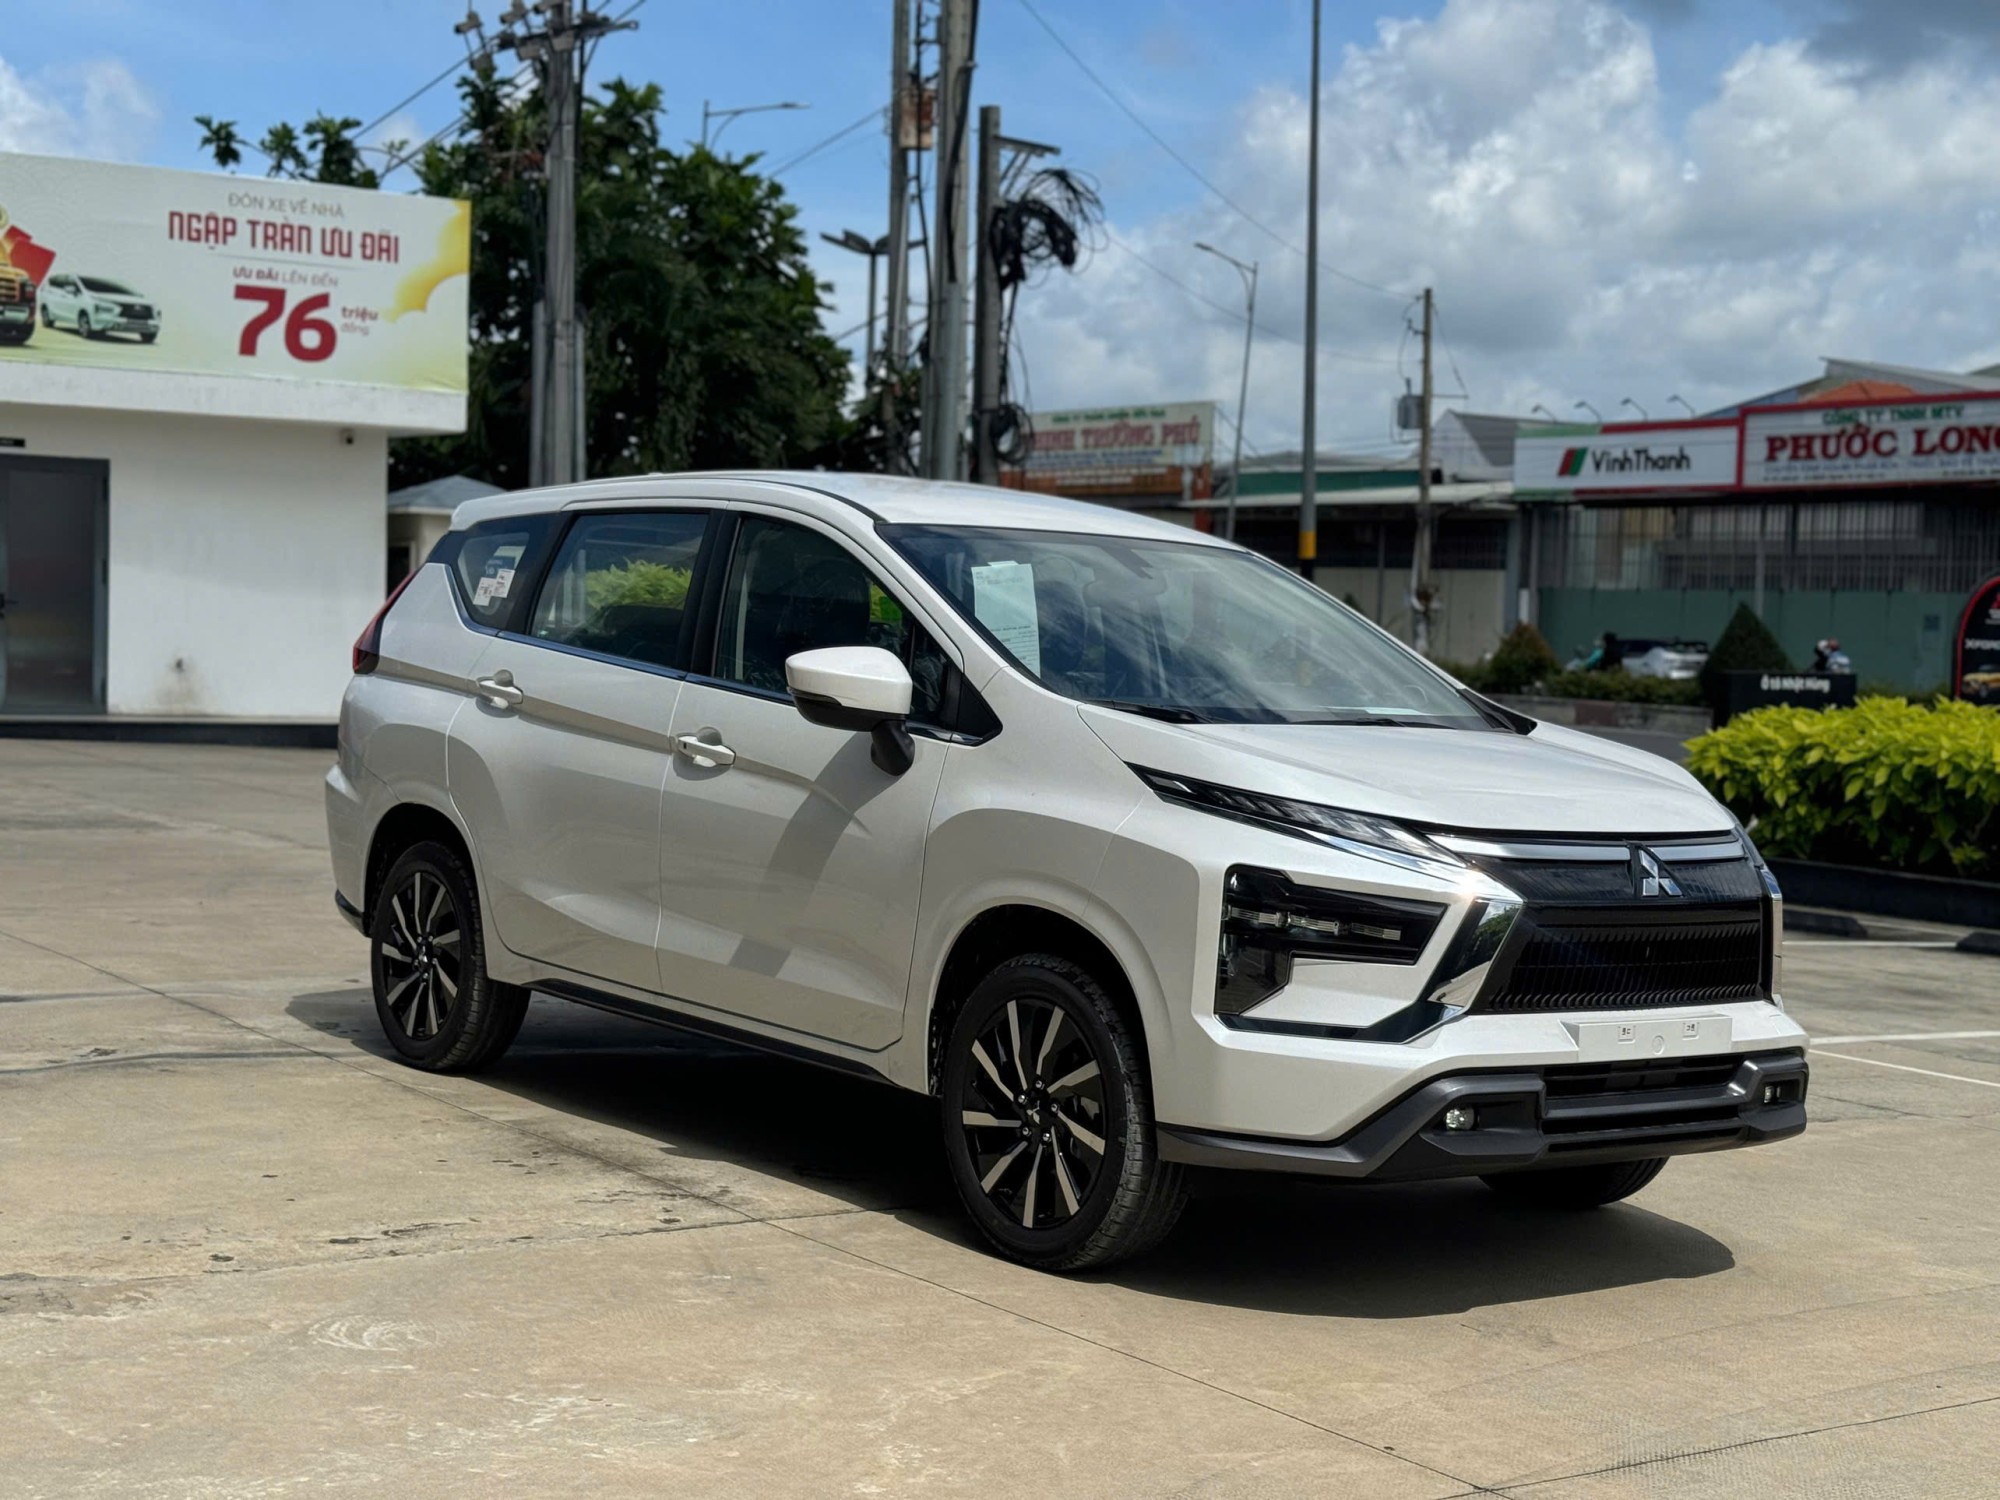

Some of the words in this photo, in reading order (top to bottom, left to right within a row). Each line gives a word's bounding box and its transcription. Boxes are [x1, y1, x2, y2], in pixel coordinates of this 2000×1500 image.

[268, 197, 286, 212] XE
[168, 210, 237, 249] NGẬP
[247, 217, 312, 254] TRÀN
[321, 226, 353, 259] ƯU
[360, 229, 399, 264] ĐÃI
[232, 265, 253, 279] ƯU
[256, 267, 279, 281] ĐÃI
[341, 306, 378, 322] triệu
[234, 284, 337, 362] 76
[1865, 408, 1884, 423] TY
[1765, 422, 1898, 462] PHƯỚC
